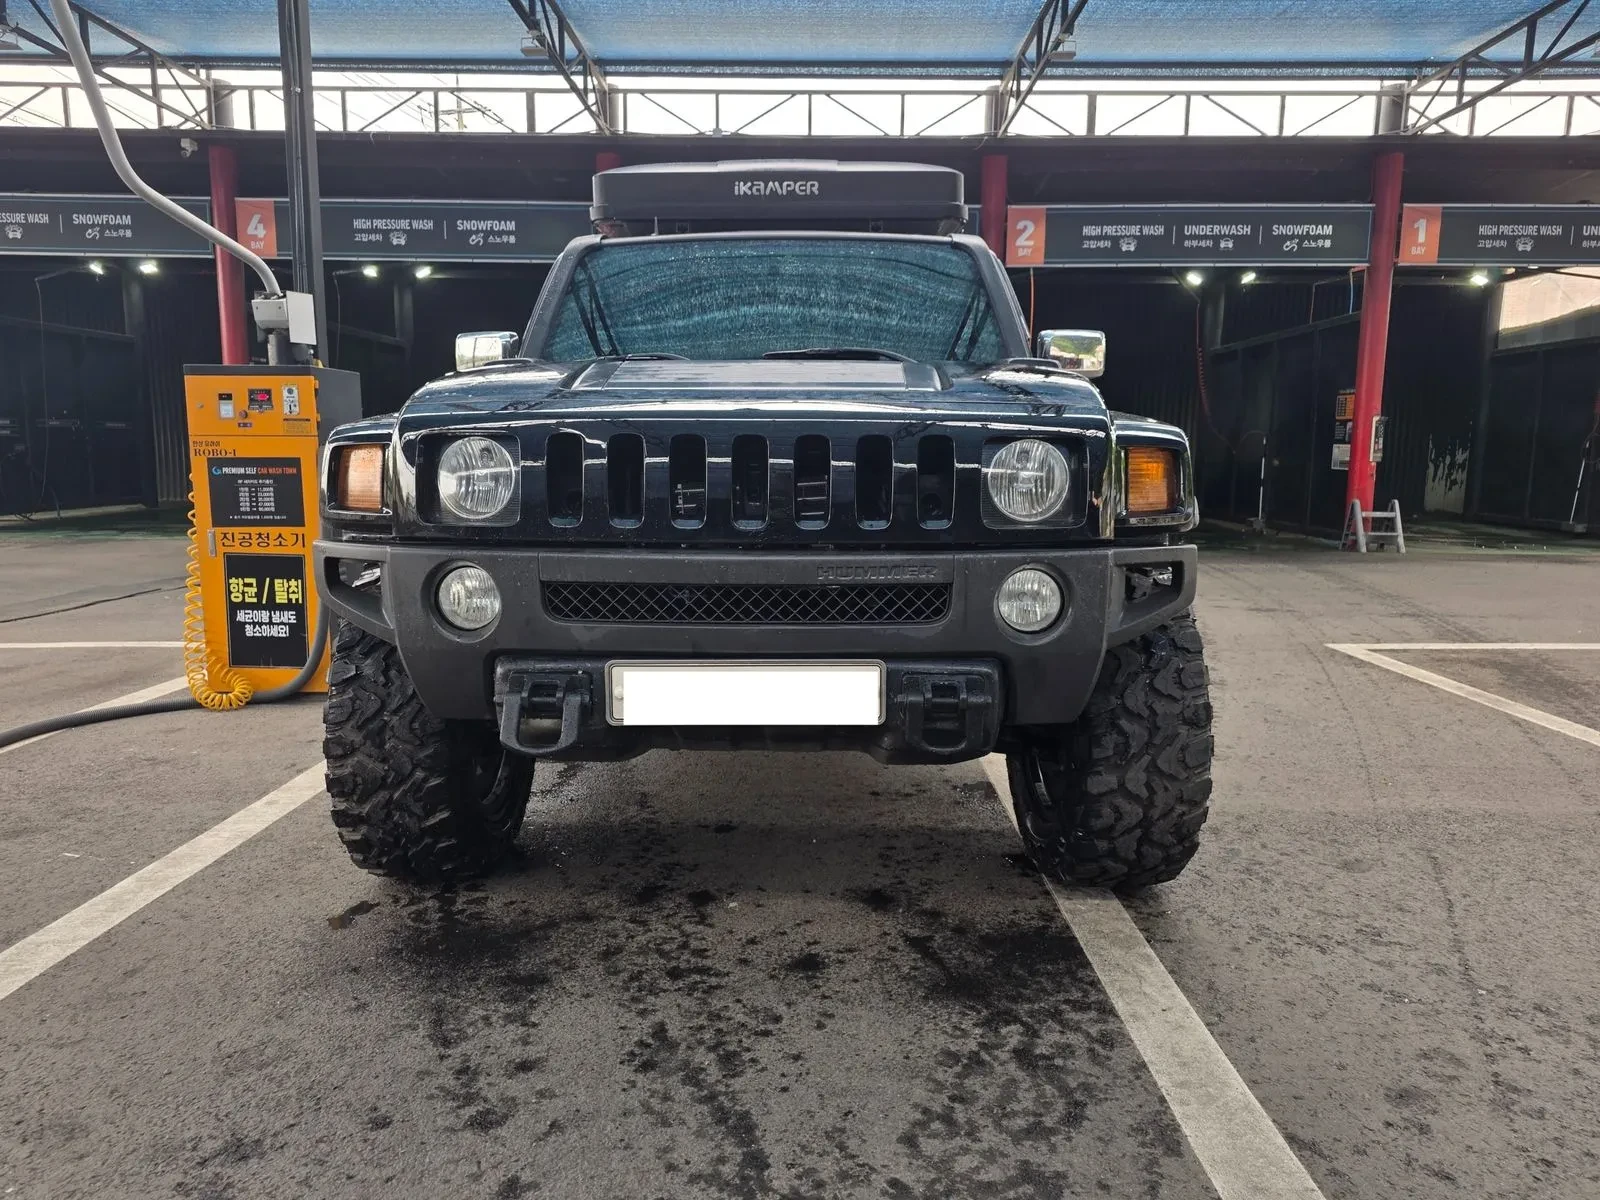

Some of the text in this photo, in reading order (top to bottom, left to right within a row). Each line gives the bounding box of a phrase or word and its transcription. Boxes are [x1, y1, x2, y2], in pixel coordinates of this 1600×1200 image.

[27, 213, 49, 224] WASH
[72, 214, 132, 225] SNOWFOAM
[353, 218, 433, 230] HIGH PRESSURE WASH
[247, 214, 267, 238] 4
[457, 220, 516, 231] SNOWFOAM
[1082, 225, 1165, 236] HIGH PRESSURE WASH
[1184, 224, 1251, 236] UNDERWASH
[1272, 224, 1333, 236] SNOWFOAM
[1413, 218, 1428, 243] 1
[1478, 225, 1563, 236] HIGH PRESSURE WASH
[1583, 225, 1600, 236] UN
[1015, 220, 1035, 247] 2
[250, 241, 265, 250] BAY
[1411, 246, 1427, 256] BAY
[1017, 248, 1032, 257] BAY
[220, 531, 306, 549] 진공청소기
[816, 565, 938, 580] HUMMER
[274, 578, 303, 604] 탈취
[236, 610, 297, 623] 세균이랑 냄새도
[244, 624, 290, 637] 청소하세요!
